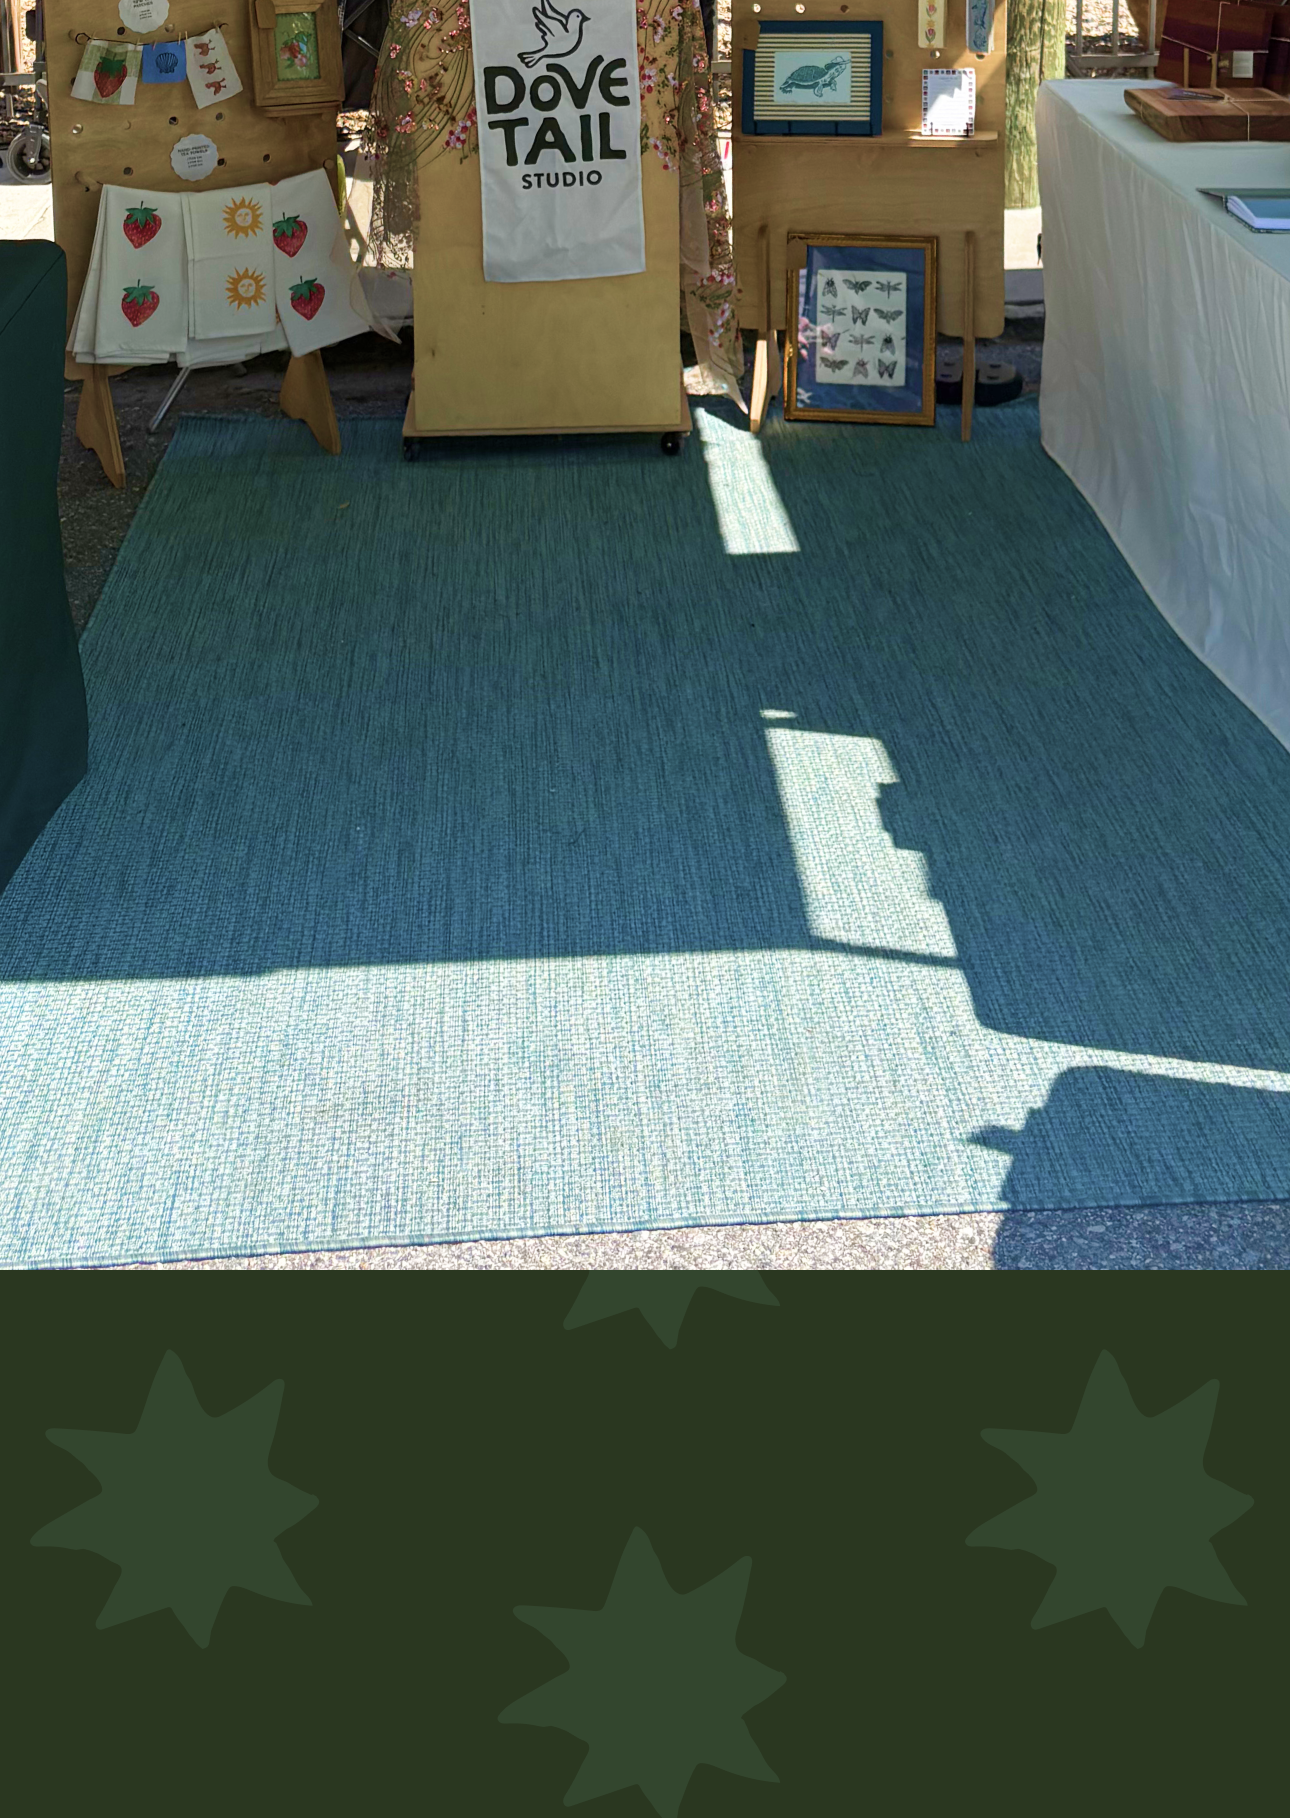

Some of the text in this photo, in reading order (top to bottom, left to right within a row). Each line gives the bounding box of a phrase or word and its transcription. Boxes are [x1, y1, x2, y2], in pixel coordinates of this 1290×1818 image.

[483, 54, 630, 114] DOVE
[488, 112, 627, 166] TAIL
[521, 170, 603, 190] STUDIO
